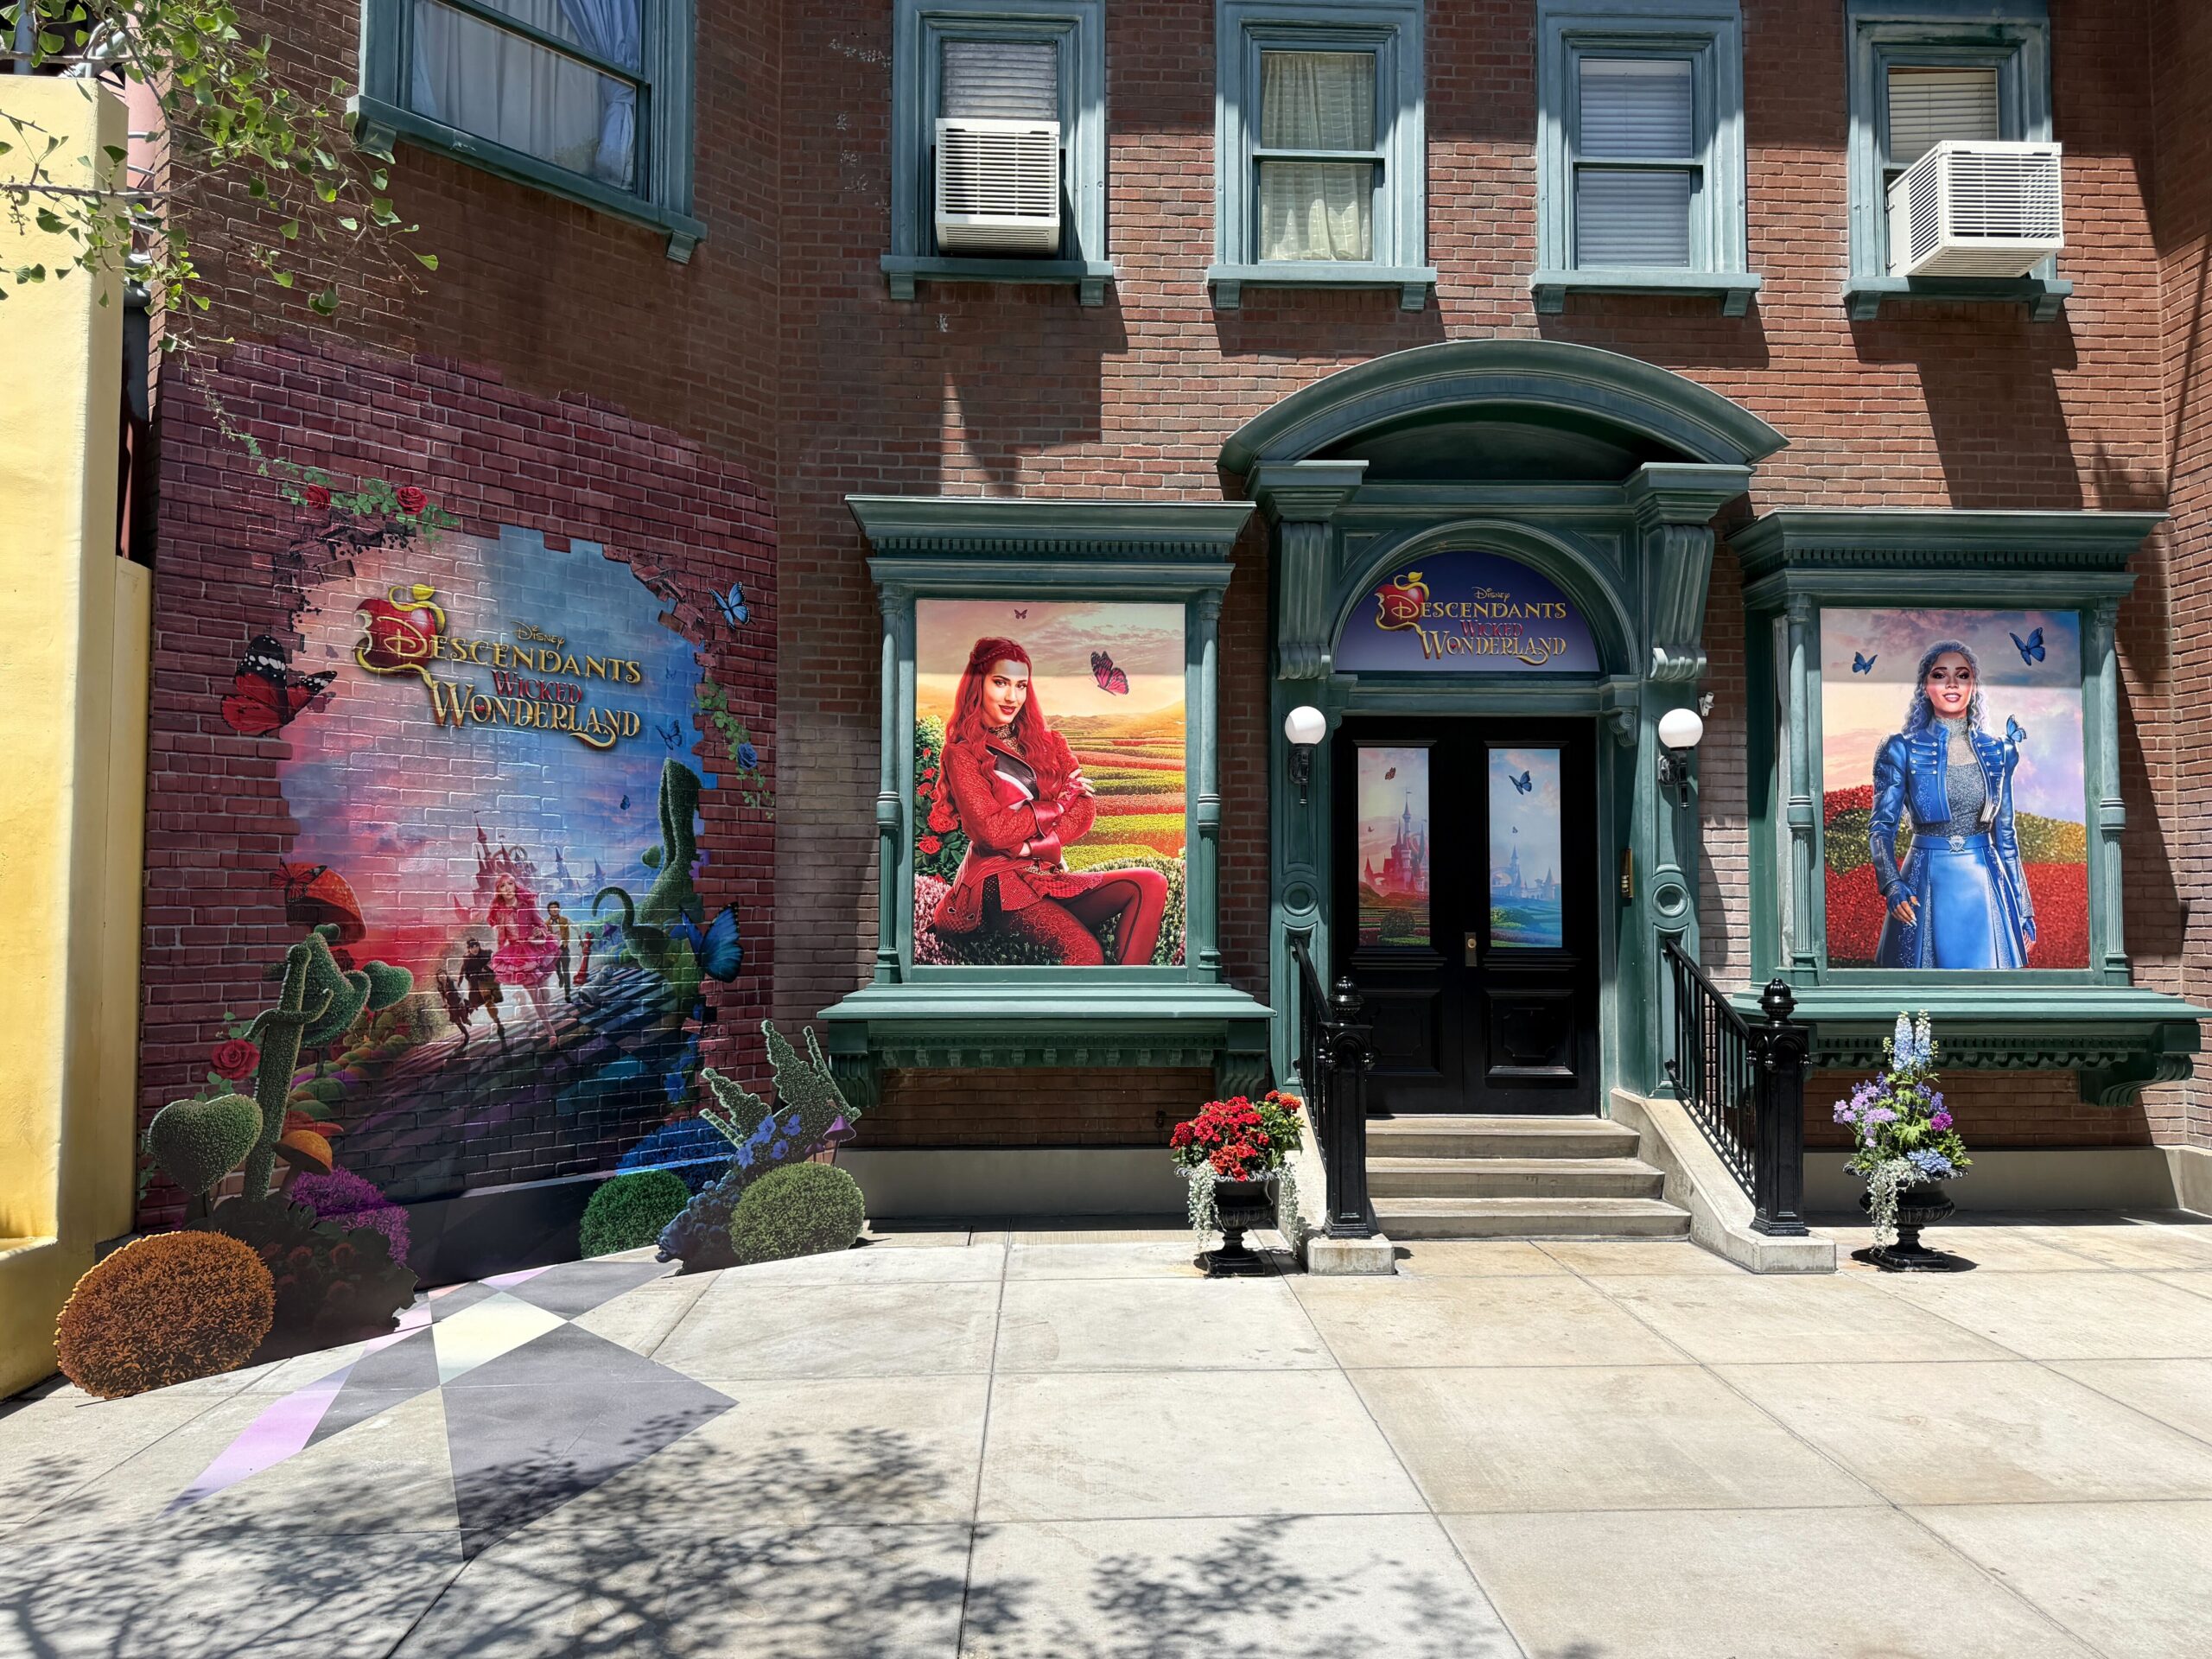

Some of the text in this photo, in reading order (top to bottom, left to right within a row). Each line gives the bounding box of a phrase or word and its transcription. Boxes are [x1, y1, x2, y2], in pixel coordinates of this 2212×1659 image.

[1387, 594, 1567, 620] DESCENDANTS
[1471, 587, 1510, 602] Disney
[511, 621, 566, 650] Disney
[1460, 620, 1523, 637] WICKED
[378, 616, 643, 684] DESCENDANTS
[1420, 630, 1567, 665] WONDERLAND
[493, 669, 583, 704] WICKED
[430, 680, 641, 751] WONDERLAND
